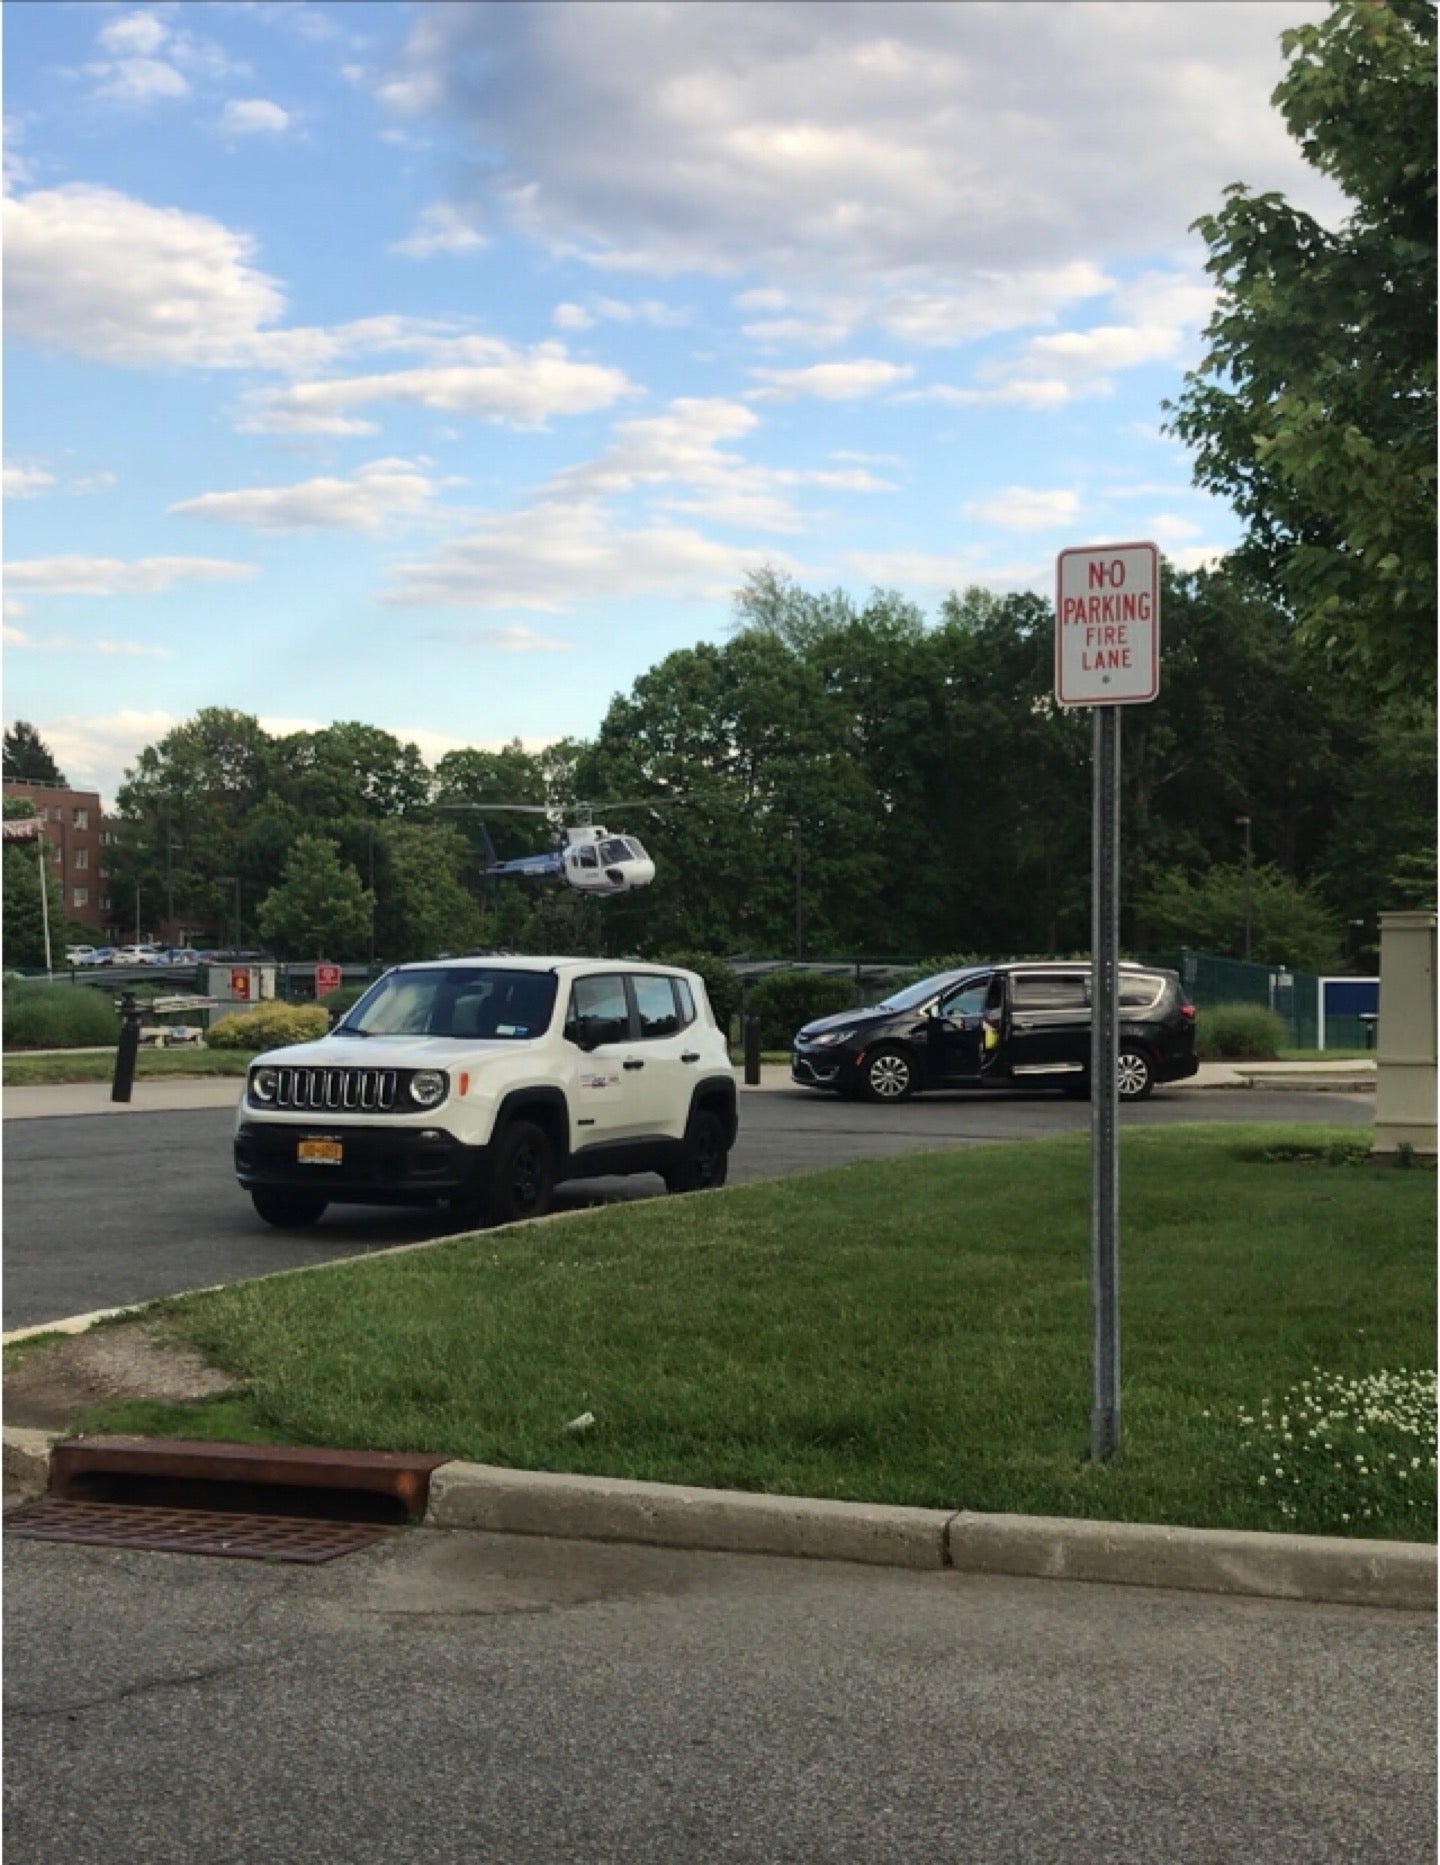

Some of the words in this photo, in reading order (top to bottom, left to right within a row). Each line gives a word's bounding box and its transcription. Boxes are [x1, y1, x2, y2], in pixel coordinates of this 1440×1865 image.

[1089, 559, 1126, 589] NO
[1063, 592, 1151, 625] PARKING
[1086, 625, 1128, 646] FIRE
[1082, 648, 1132, 671] LANE
